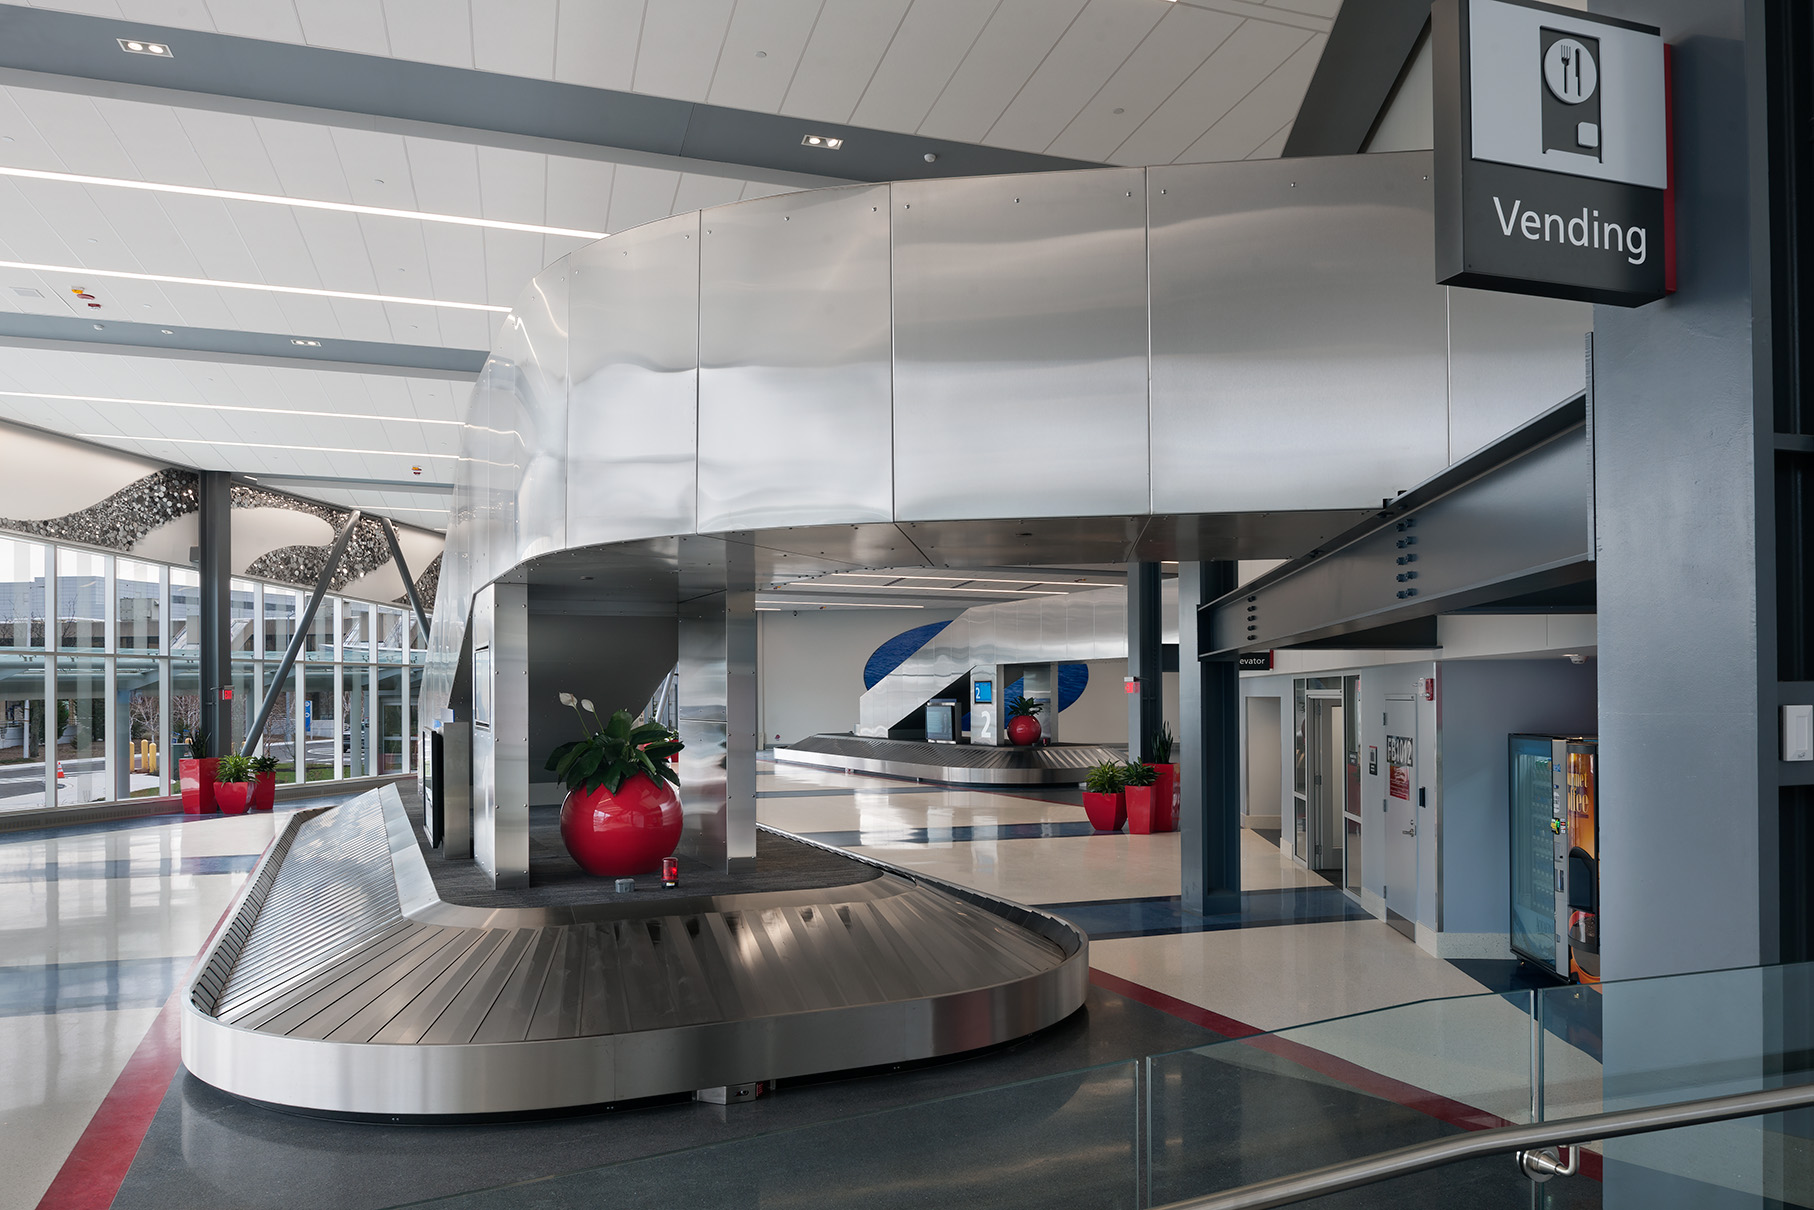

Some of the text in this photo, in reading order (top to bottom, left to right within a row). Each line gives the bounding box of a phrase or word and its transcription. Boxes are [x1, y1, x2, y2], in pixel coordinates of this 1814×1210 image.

[1493, 196, 1647, 265] Vending
[975, 686, 981, 699] 2
[981, 710, 992, 738] 2
[1387, 737, 1412, 765] FB1012
